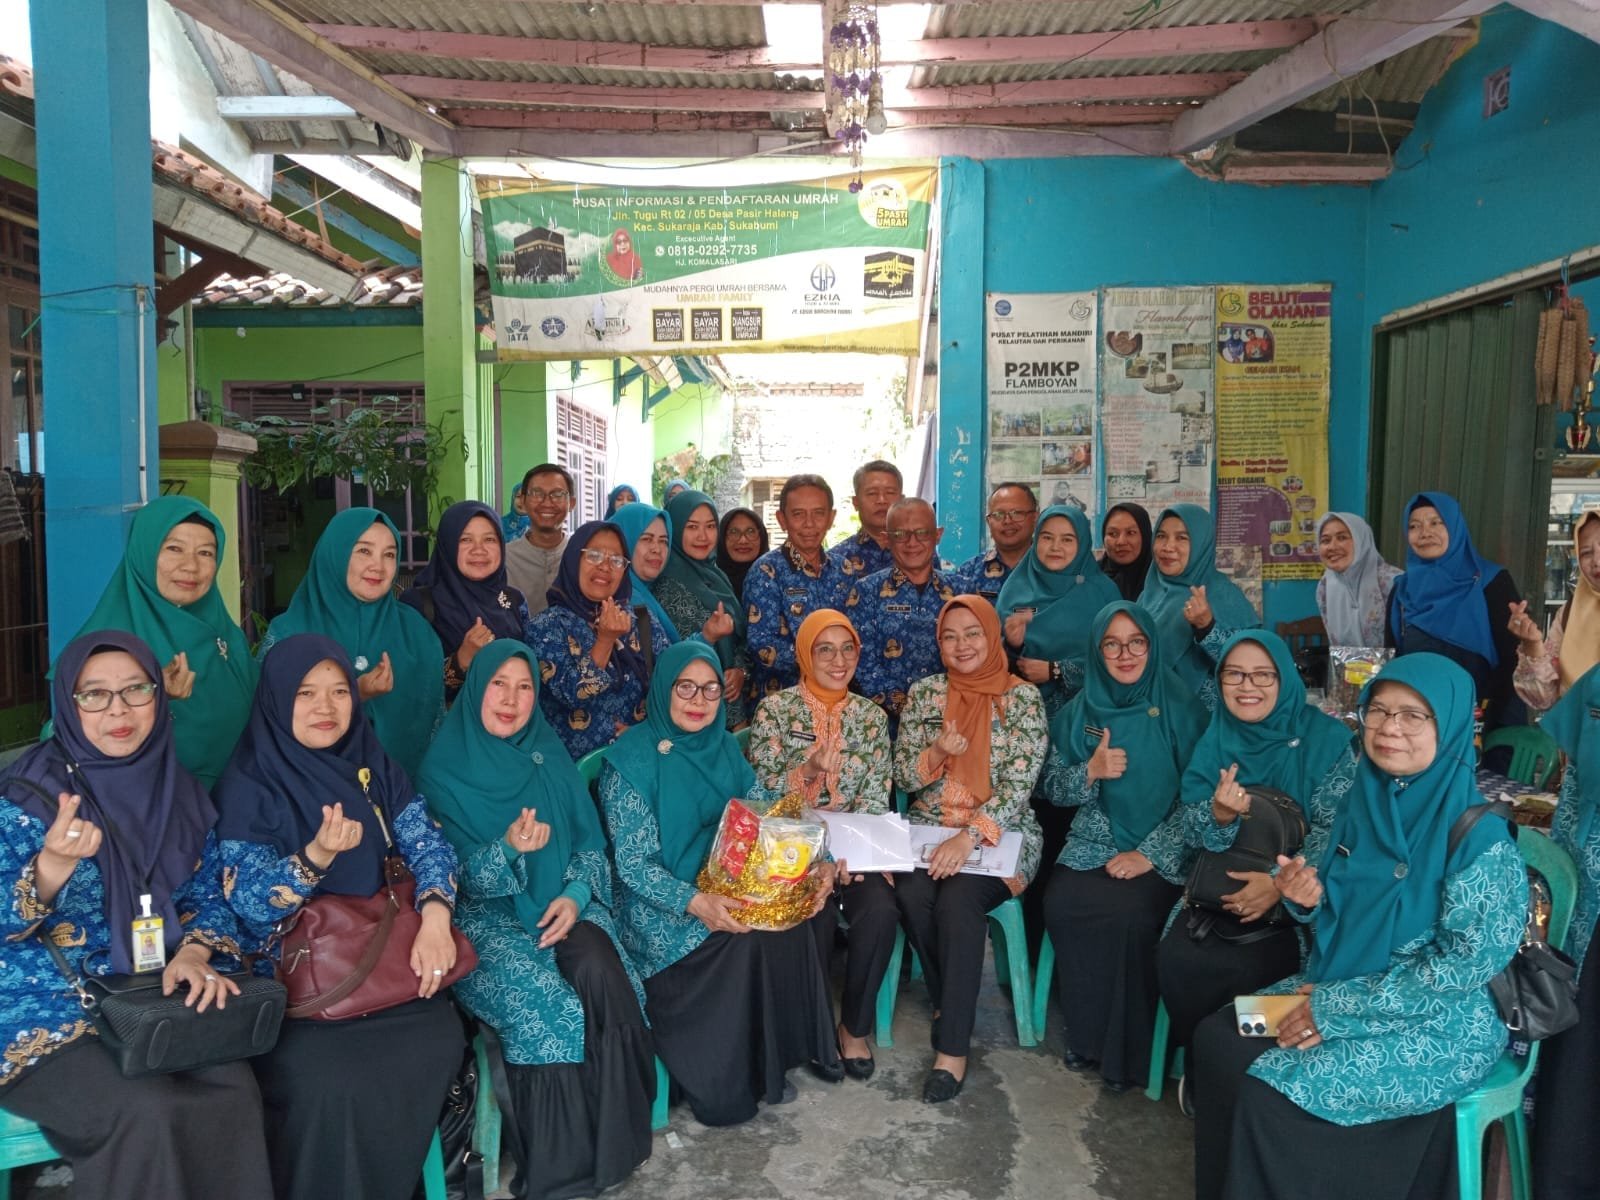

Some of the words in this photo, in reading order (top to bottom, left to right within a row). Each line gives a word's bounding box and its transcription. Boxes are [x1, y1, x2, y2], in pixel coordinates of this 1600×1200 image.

[572, 197, 612, 208] PUSAT
[615, 196, 684, 206] INFORMASI
[687, 196, 696, 205] &
[699, 194, 790, 205] PENDAFTARAN
[793, 193, 839, 204] UMRAH
[612, 211, 630, 220] Jln.
[633, 210, 658, 222] Tugu
[661, 210, 672, 219] Rt
[674, 209, 686, 219] 02
[694, 209, 706, 218] 05
[709, 209, 734, 218] Desa
[736, 208, 762, 218] Pasir
[764, 208, 799, 219] Halang
[658, 222, 701, 232] Sukaraja
[729, 220, 779, 230] Sukabumi
[667, 244, 758, 256] 0818-0292-7735
[644, 284, 689, 293] MUDAHNYA
[690, 284, 715, 293] PERGI
[716, 283, 747, 292] UMRAH
[747, 283, 787, 292] BERSAMA
[1248, 291, 1298, 305] BELUT
[1247, 304, 1316, 319] OLAHAN
[655, 318, 681, 328] BAYAR
[694, 317, 719, 328] BAYAR
[991, 331, 1016, 339] PUSAT
[1005, 361, 1080, 378] P2MKP
[1006, 378, 1078, 389] FLAMBOYAN
